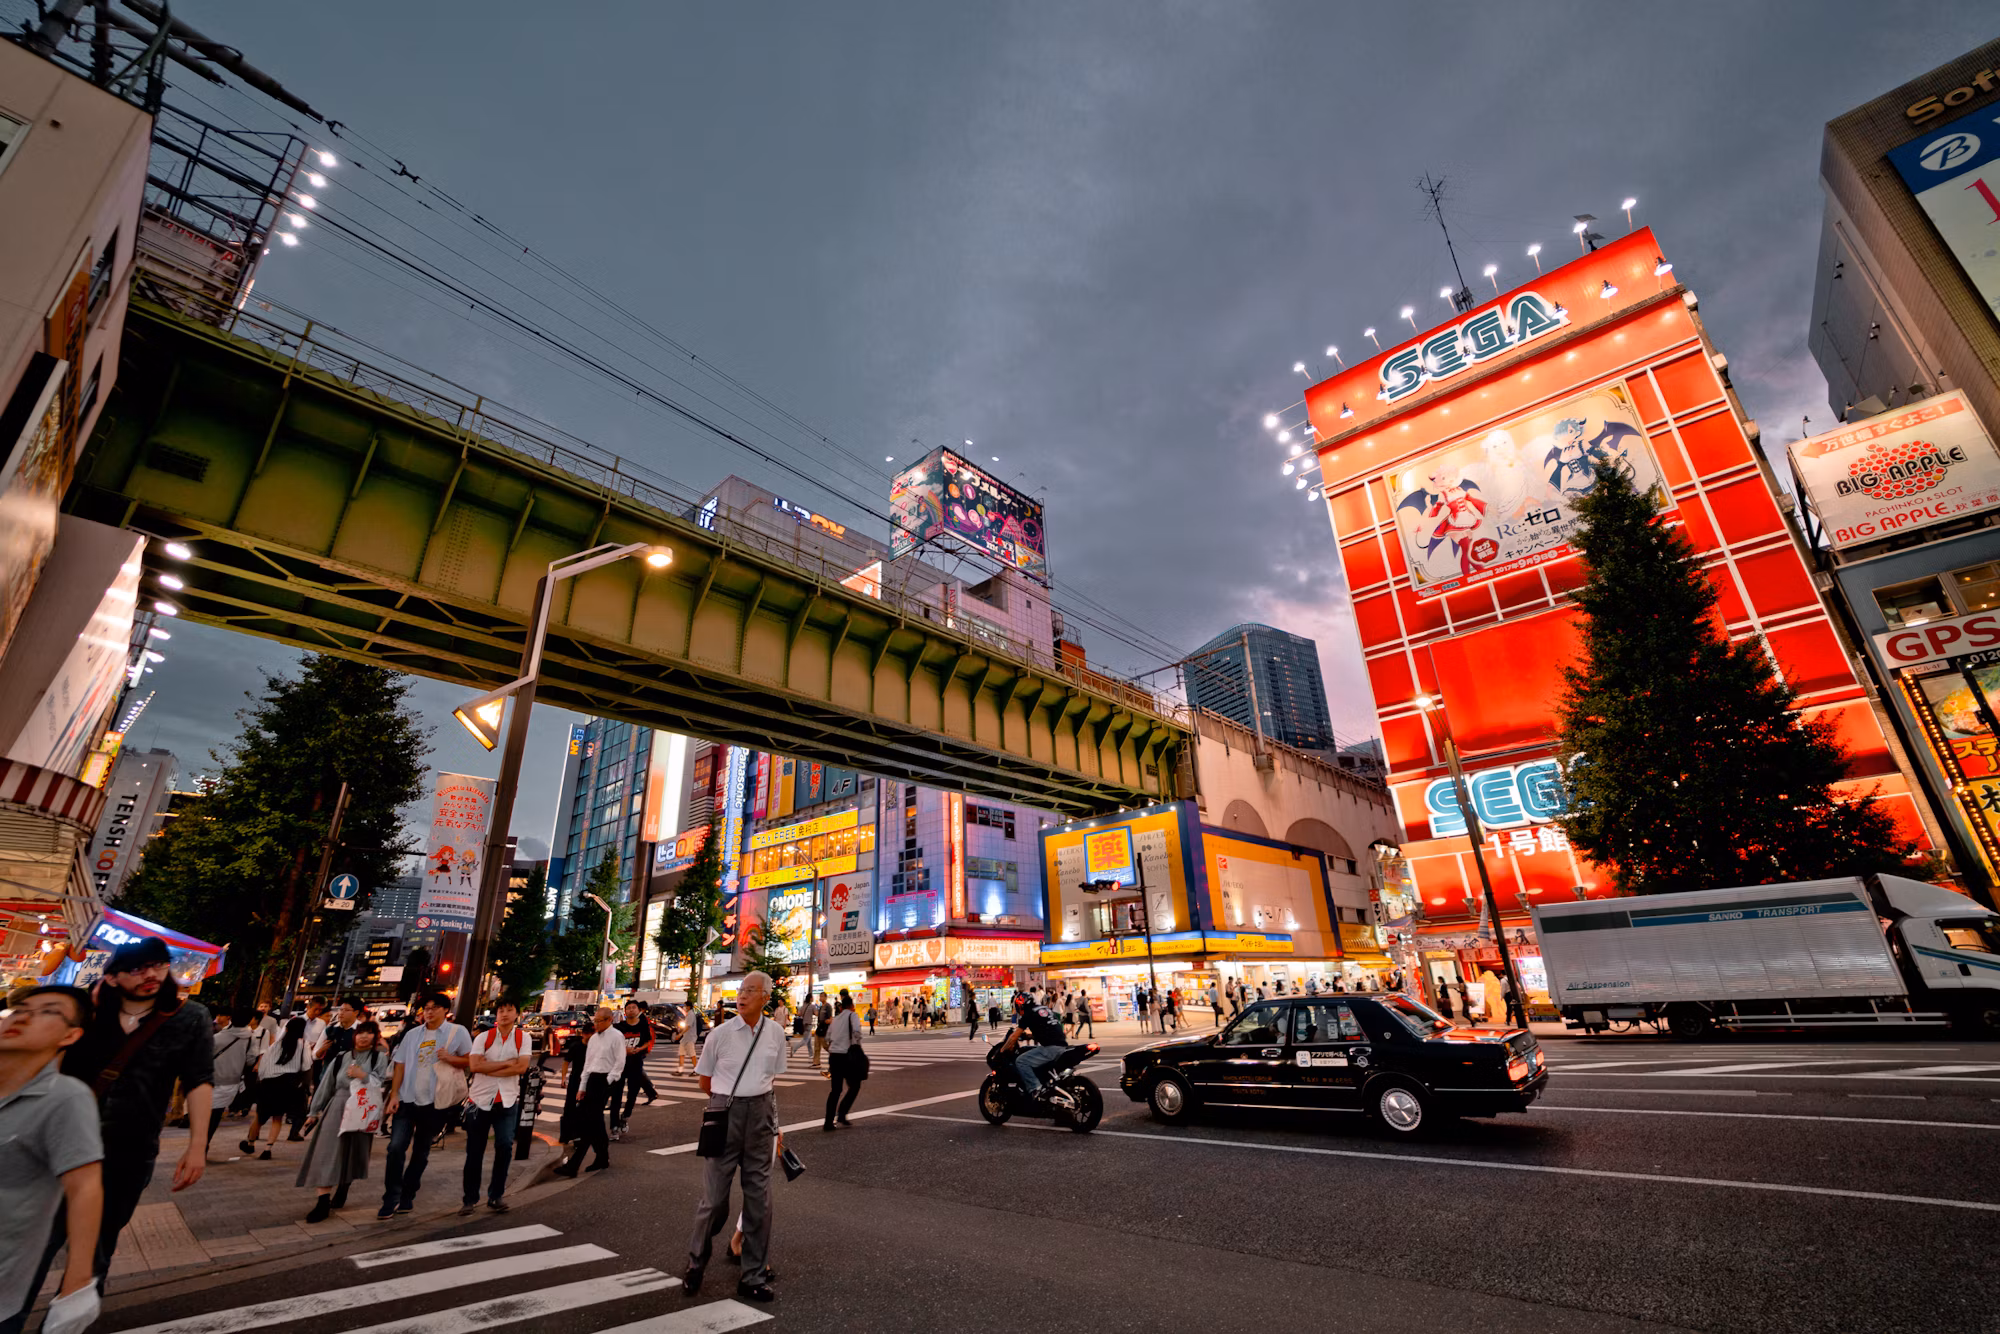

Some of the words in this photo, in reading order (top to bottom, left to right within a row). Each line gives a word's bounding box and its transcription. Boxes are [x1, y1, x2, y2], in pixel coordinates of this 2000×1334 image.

[1379, 291, 1571, 405] SEGA
[1834, 472, 1881, 497] BIG
[1887, 446, 1967, 482] APPLE
[1865, 498, 1924, 518] PACHINKO
[1934, 486, 1963, 501] SLOT
[1517, 516, 1577, 546] から始める異世界
[1836, 521, 1875, 542] BIG
[1505, 534, 1565, 559] キャンペーン
[735, 747, 750, 809] Panasonic
[832, 778, 852, 795] 4F
[730, 818, 743, 871] ONODEN
[1092, 833, 1125, 869] 薬
[1488, 826, 1569, 858] 1号館
[1144, 852, 1173, 862] Kanebo
[1056, 868, 1080, 877] Kanebo
[544, 886, 558, 919] AKIBA
[1708, 912, 1743, 921] SANKO
[1757, 905, 1823, 917] TRANSPORT
[431, 919, 440, 927] No
[440, 919, 463, 930] Smoking
[463, 921, 474, 930] Area
[829, 941, 870, 956] ONODEN
[1582, 980, 1630, 989] Suspension
